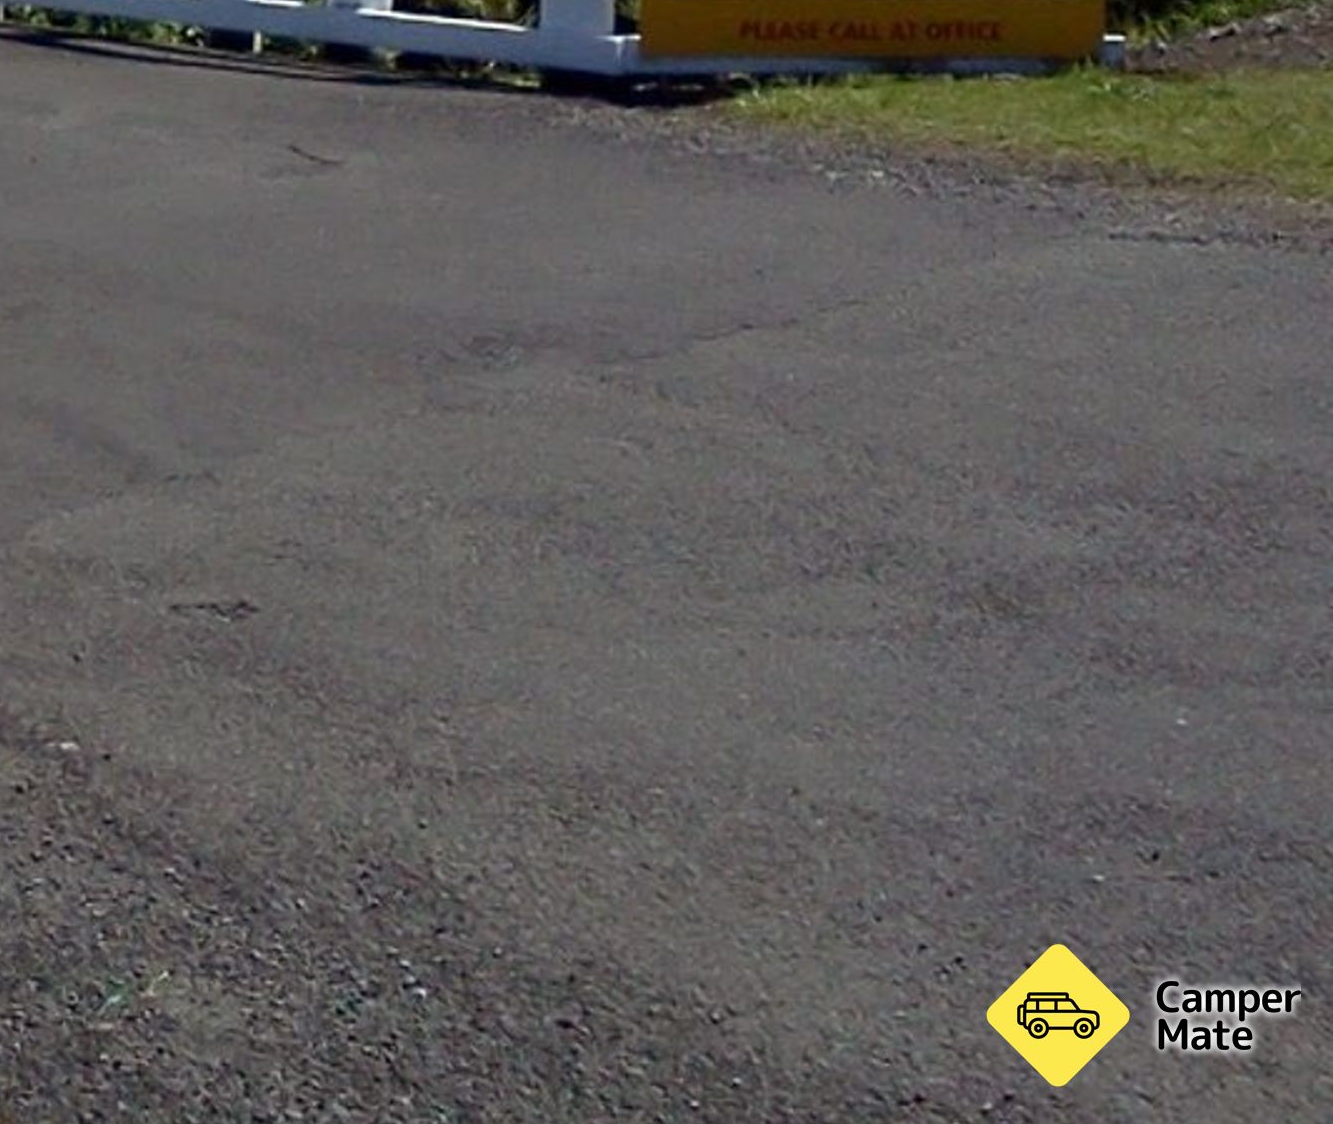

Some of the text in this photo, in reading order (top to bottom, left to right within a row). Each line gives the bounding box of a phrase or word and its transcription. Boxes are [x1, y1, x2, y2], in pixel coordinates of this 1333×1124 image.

[739, 21, 1002, 42] PLEASE CALL AT OFFICE
